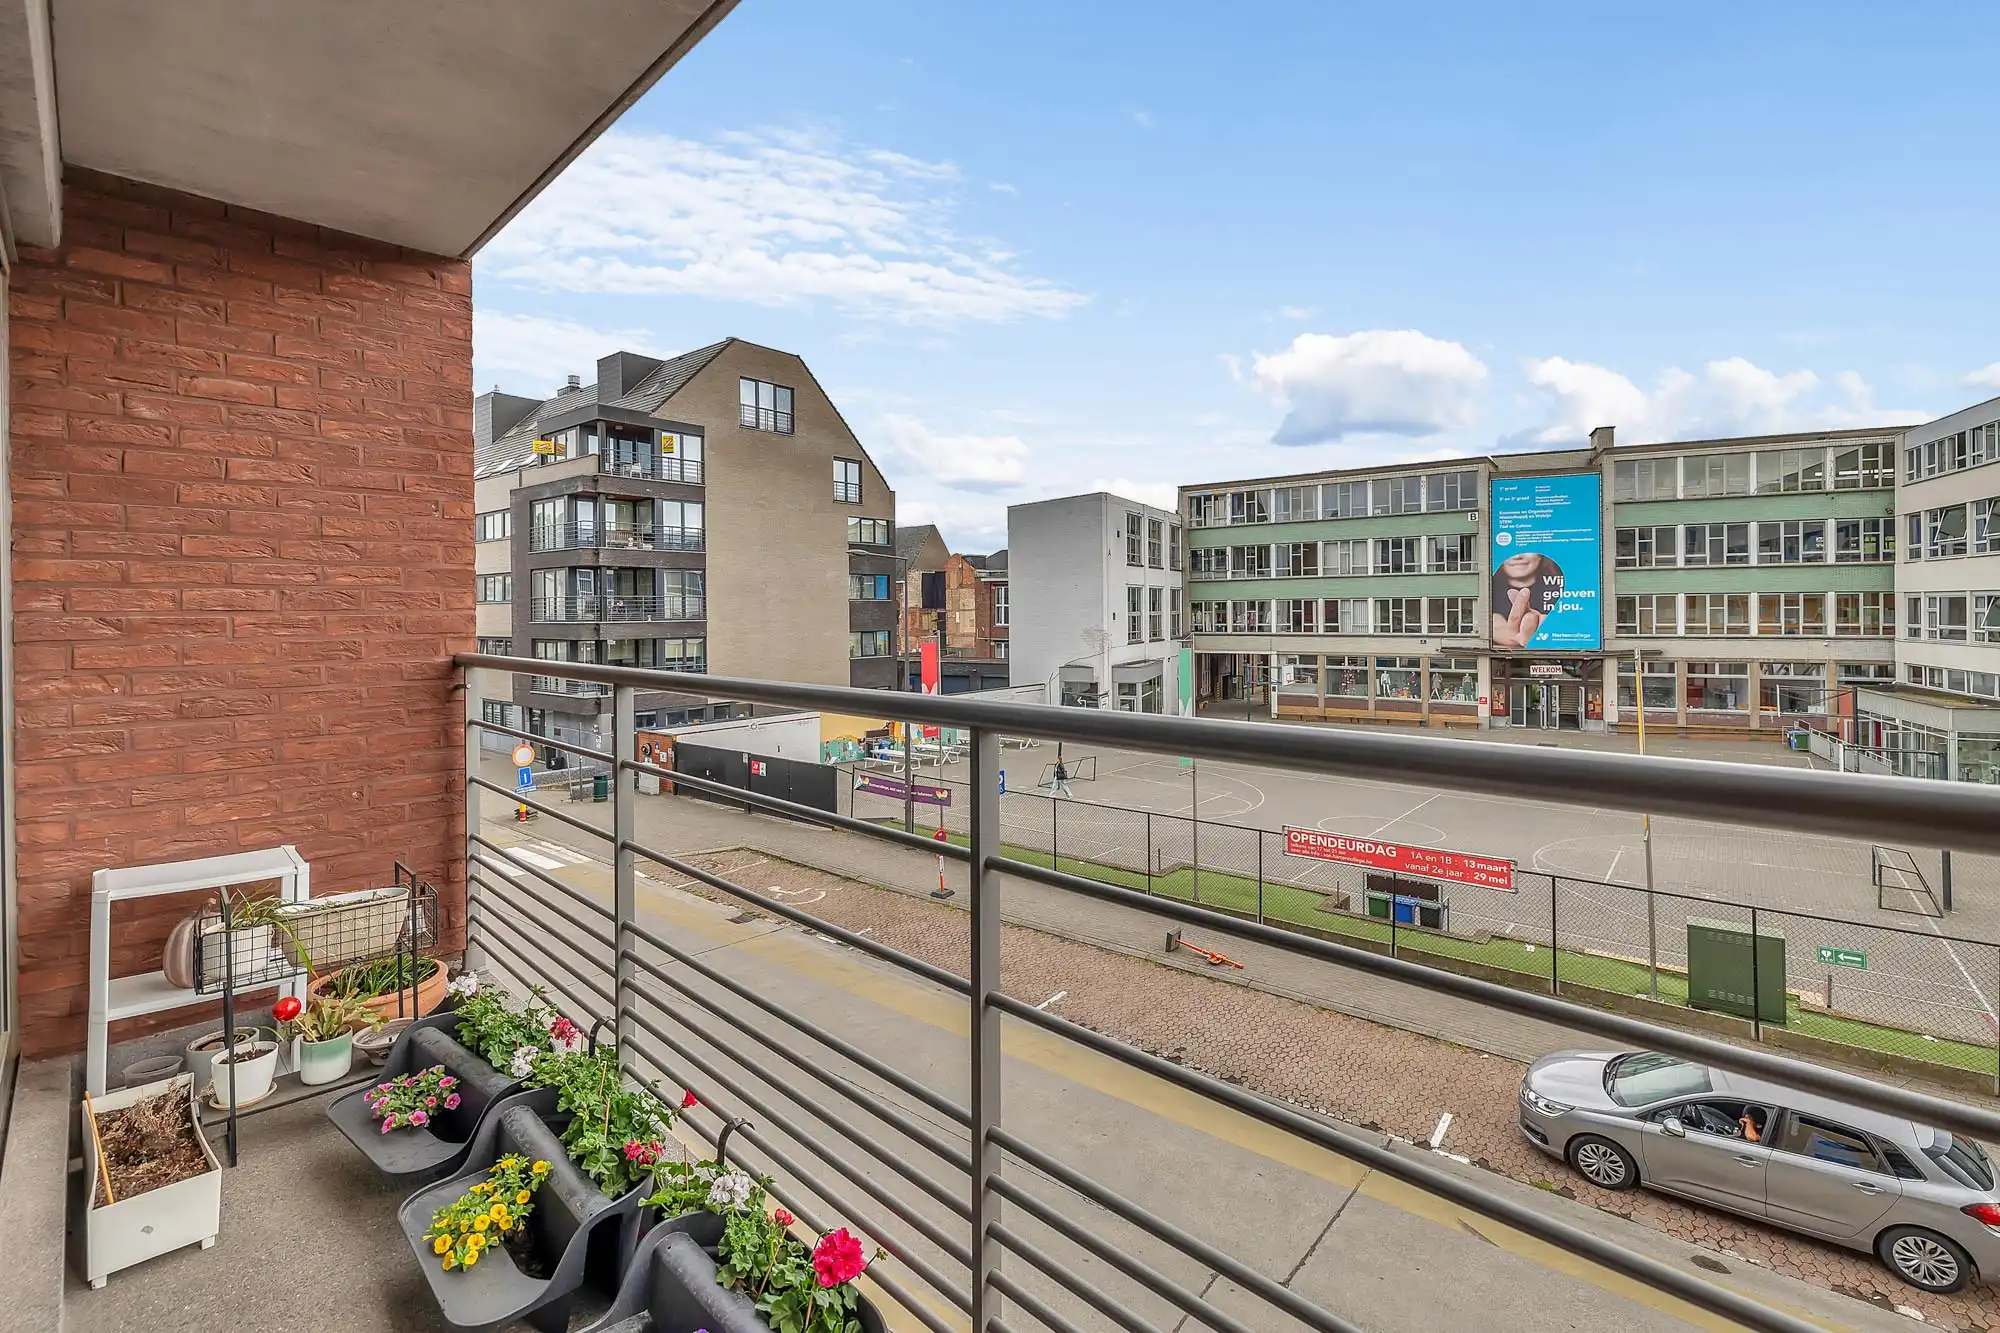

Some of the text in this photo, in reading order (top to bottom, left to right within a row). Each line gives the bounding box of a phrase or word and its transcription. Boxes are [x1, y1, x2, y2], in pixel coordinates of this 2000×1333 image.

[1542, 575, 1564, 587] Wij
[1543, 588, 1596, 601] geloven
[1543, 601, 1584, 613] in jou.
[1290, 832, 1397, 858] OPENDEURDAG
[1410, 851, 1423, 860] 1A
[1440, 856, 1452, 864] 1B
[1463, 859, 1476, 868] 13
[1477, 863, 1508, 873] maart
[1405, 863, 1430, 872] vanaf
[1431, 865, 1444, 874] 2e
[1445, 868, 1463, 877] jaar
[1474, 872, 1487, 880] 29
[1488, 876, 1508, 885] mei
